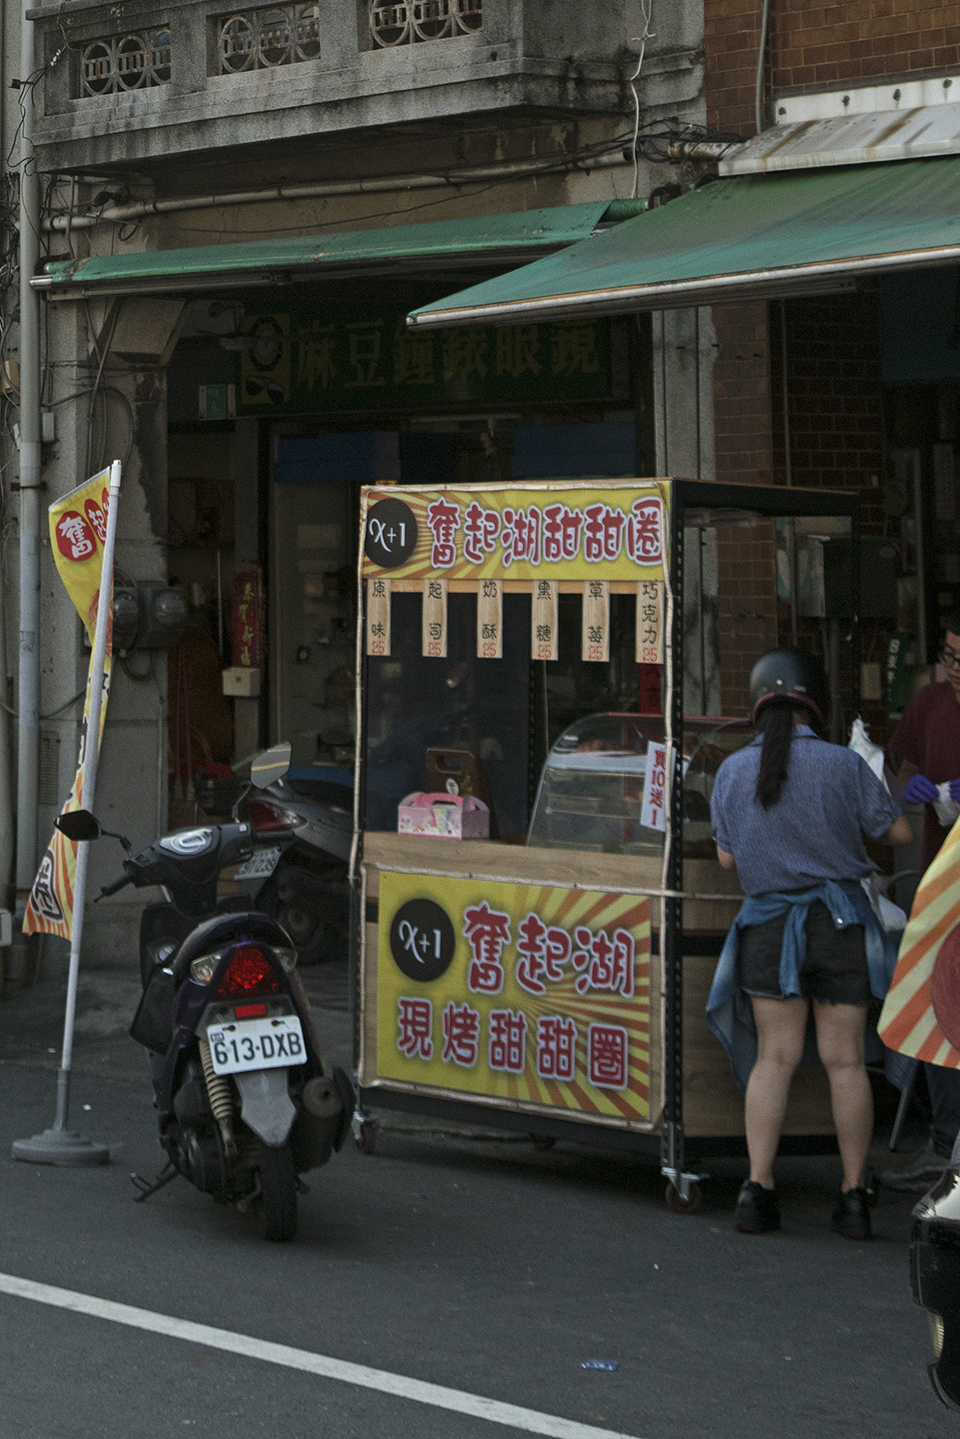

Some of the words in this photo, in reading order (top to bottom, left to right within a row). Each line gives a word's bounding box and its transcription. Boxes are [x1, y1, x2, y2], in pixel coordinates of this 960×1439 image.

[428, 495, 665, 569] 奮起湖甜甜圈
[371, 581, 386, 639] 原味
[428, 582, 443, 641] 起司
[482, 581, 498, 641] 奶酥
[536, 580, 552, 643] 黑糖
[588, 581, 604, 644] 草莓
[642, 580, 659, 645] 巧克力
[371, 641, 385, 655] 25
[428, 642, 442, 657] 25
[482, 643, 497, 658] 25
[537, 644, 552, 659] 25
[588, 645, 604, 661] 25
[642, 647, 658, 663] 25
[463, 900, 636, 1000] 奮起湖
[396, 996, 629, 1091] 現烤甜甜圈
